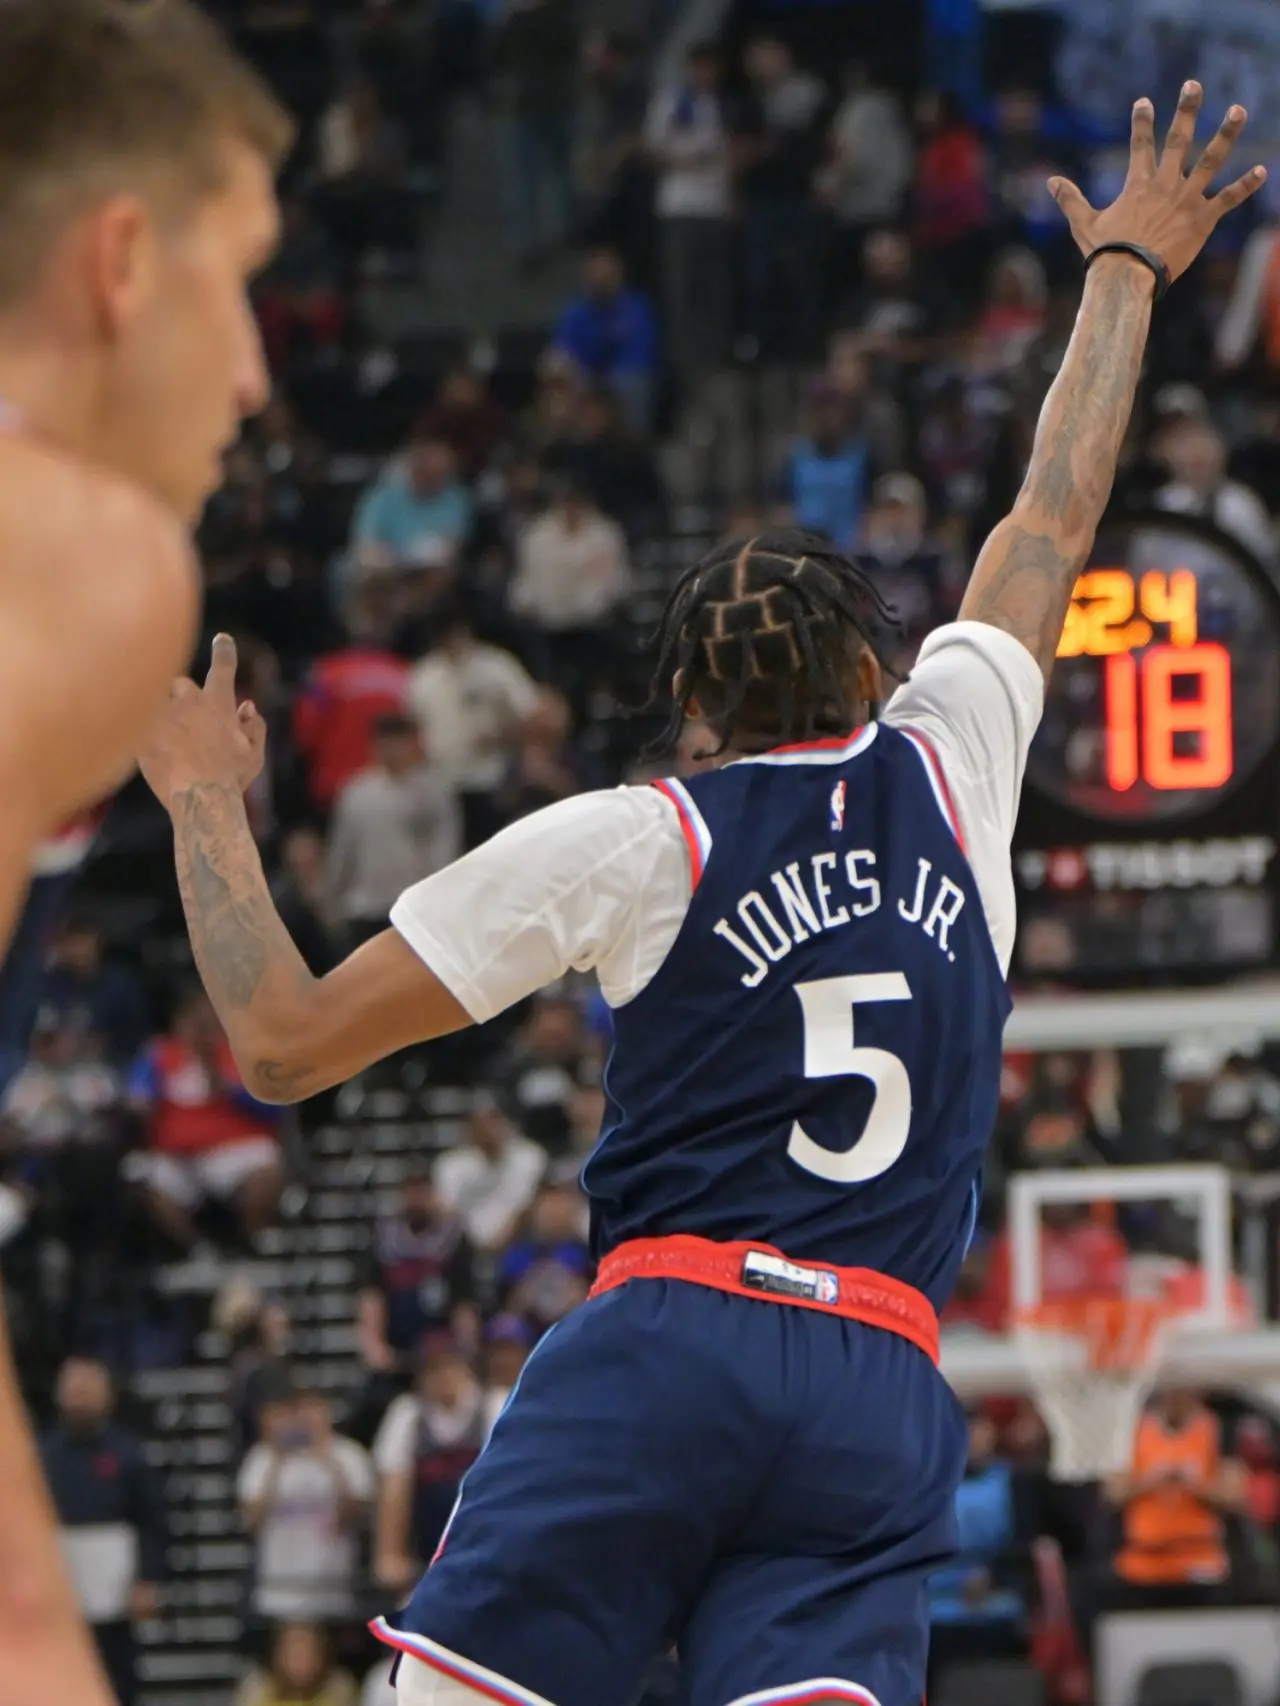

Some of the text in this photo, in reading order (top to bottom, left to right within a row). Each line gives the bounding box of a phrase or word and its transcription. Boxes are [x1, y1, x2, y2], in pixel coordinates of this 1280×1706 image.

[1105, 640, 1234, 792] 18
[713, 849, 965, 988] JONES JR.
[786, 971, 913, 1184] 5
